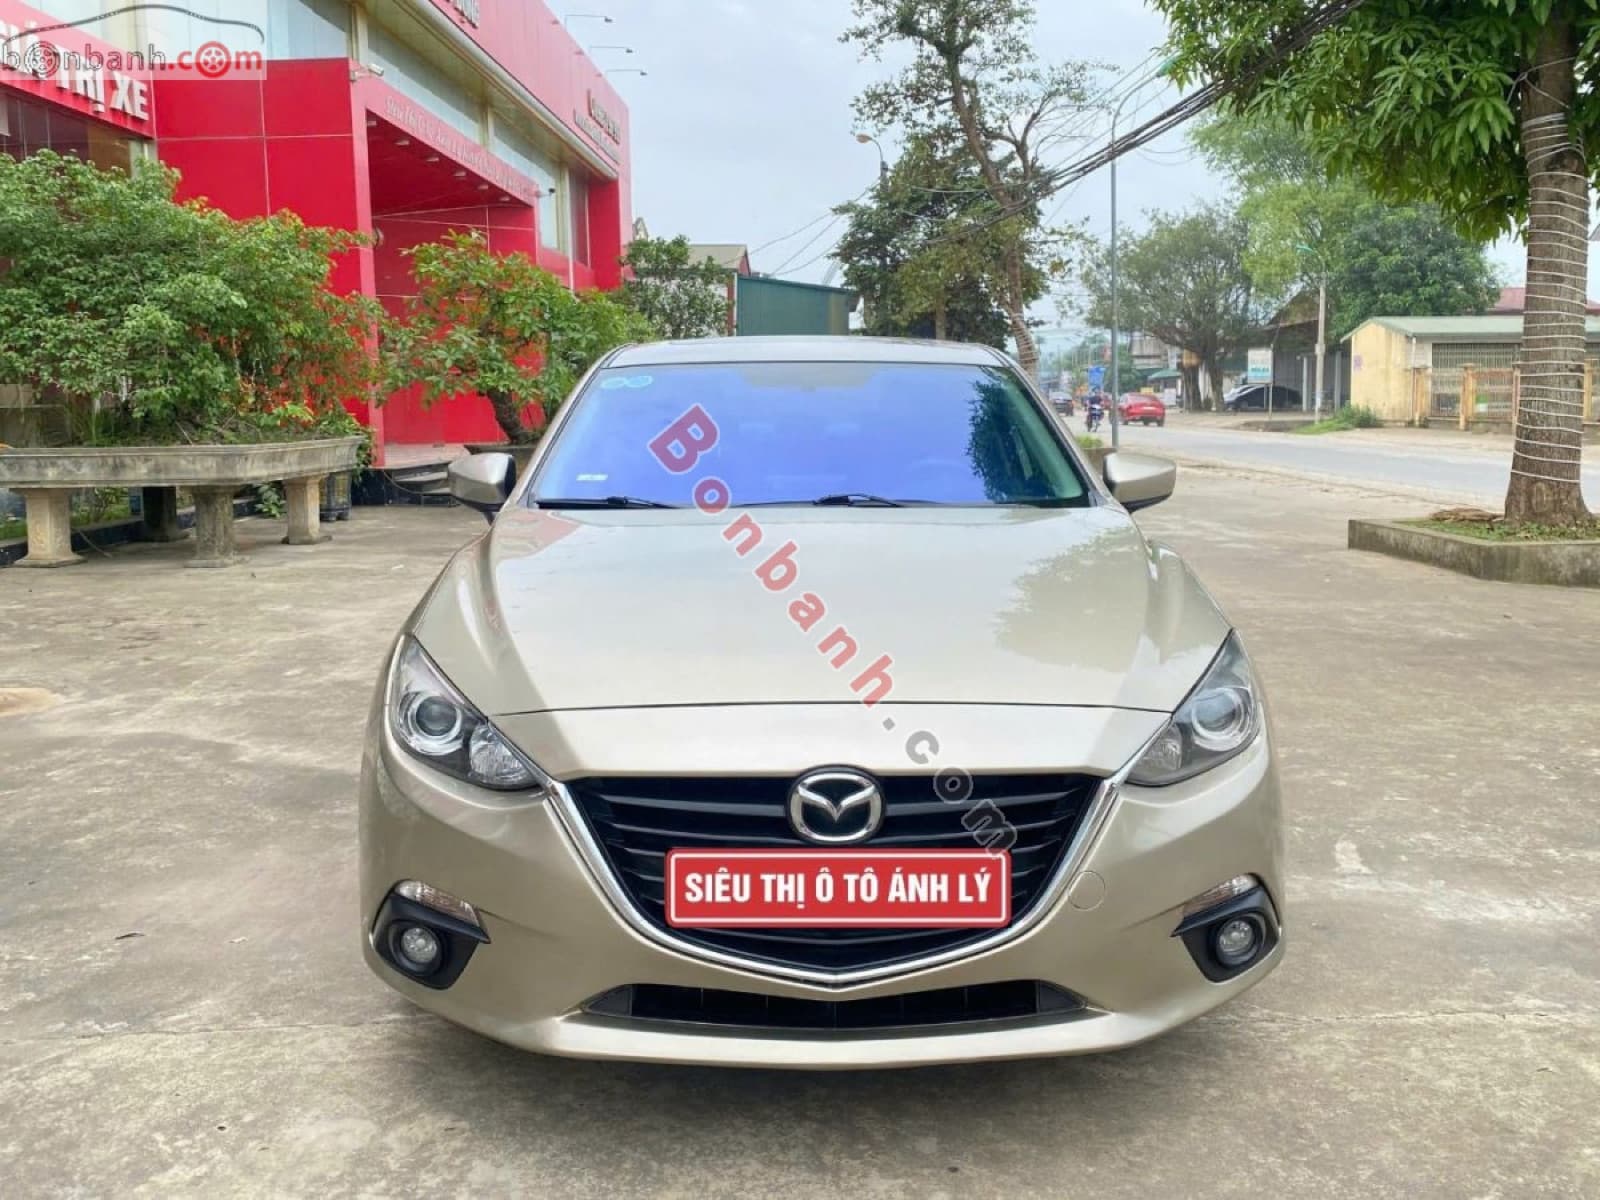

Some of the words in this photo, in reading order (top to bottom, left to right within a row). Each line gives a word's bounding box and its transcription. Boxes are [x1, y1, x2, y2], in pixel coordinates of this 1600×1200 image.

[109, 70, 149, 121] XE
[685, 867, 751, 903] SIÊU
[760, 873, 805, 909] THỊ
[815, 867, 834, 903] Ô
[843, 867, 877, 903] TÔ
[887, 867, 948, 903] ÁNH
[958, 867, 992, 903] LÝ
